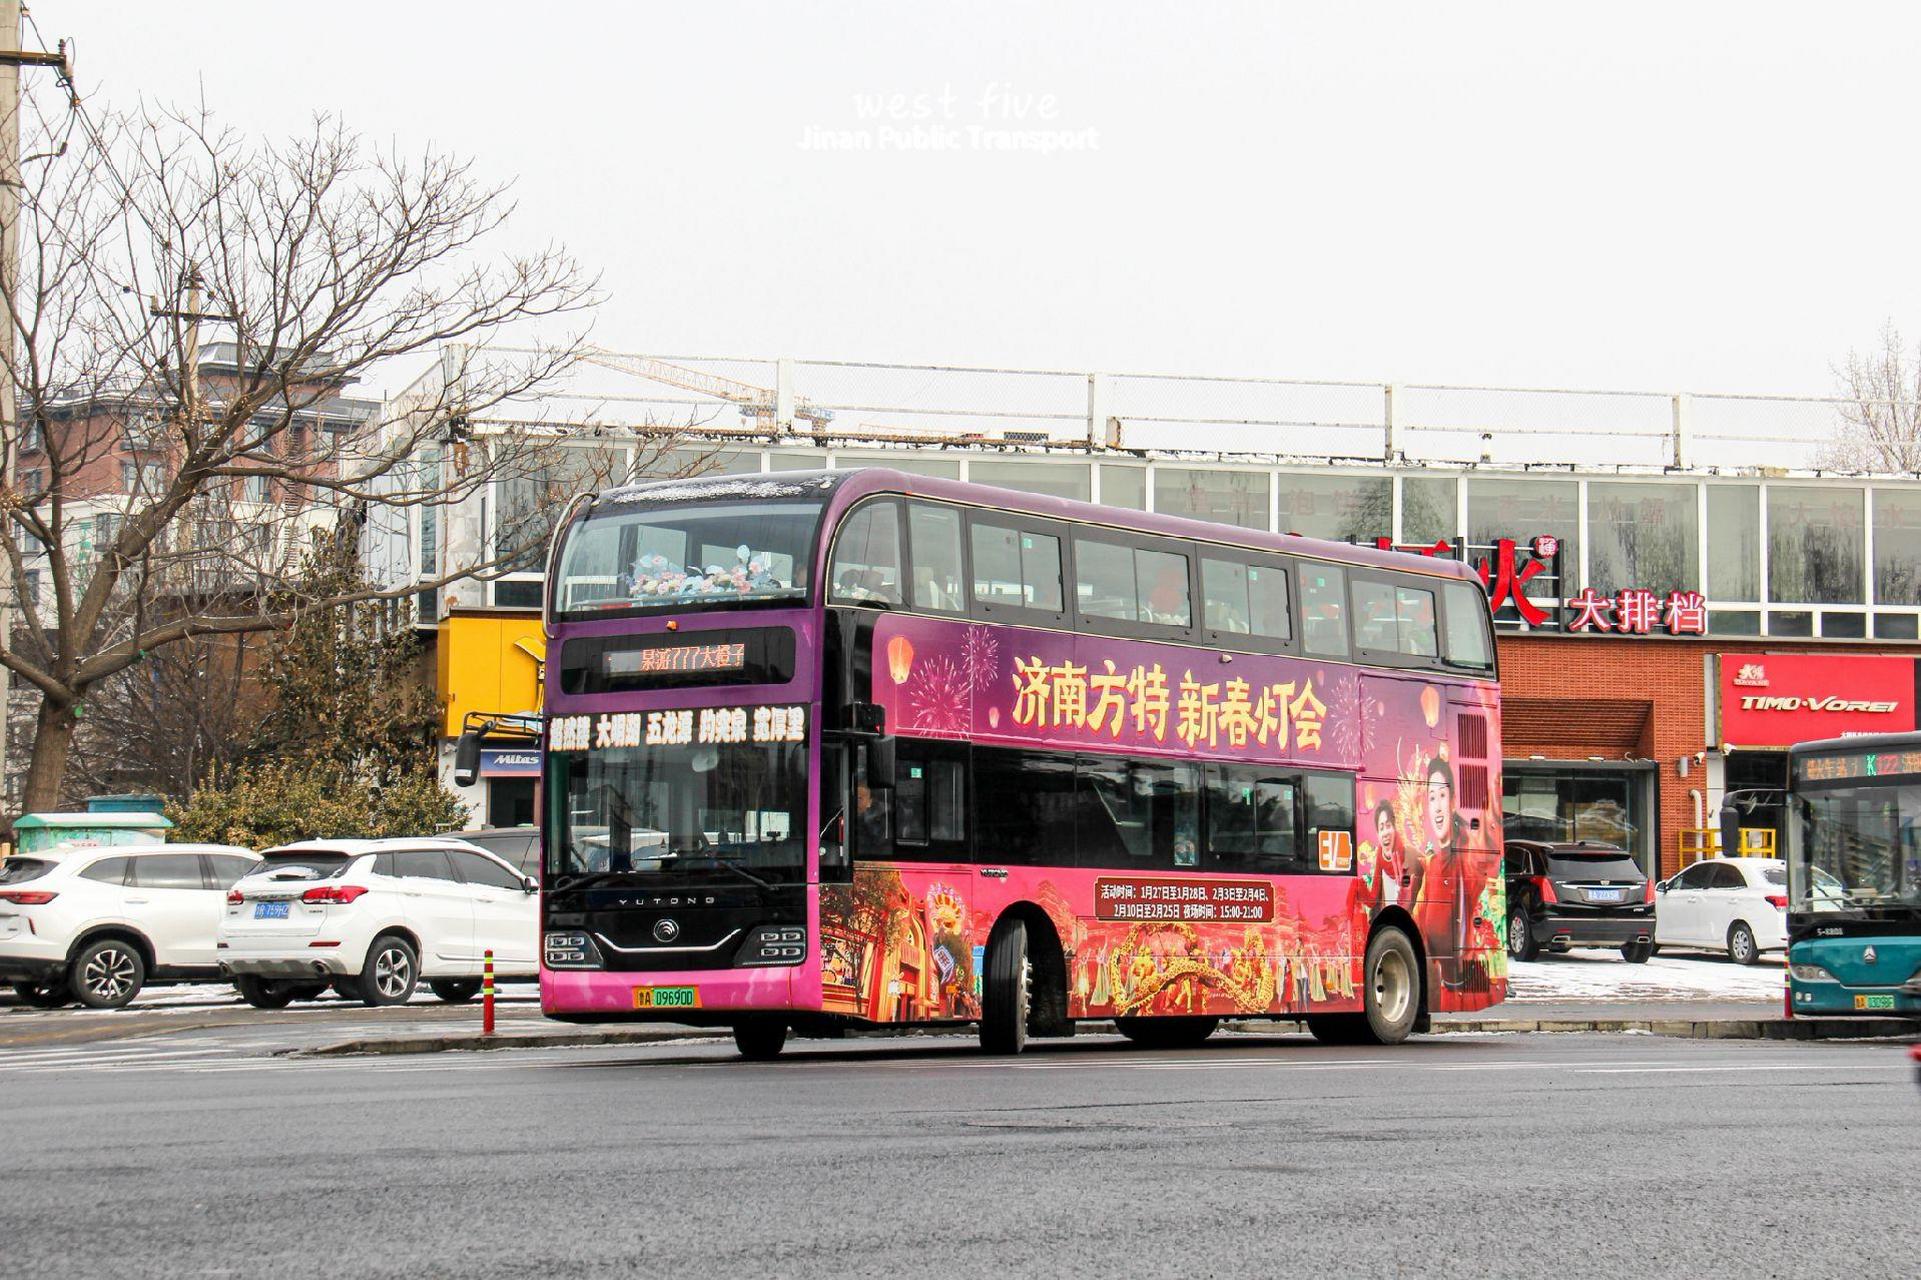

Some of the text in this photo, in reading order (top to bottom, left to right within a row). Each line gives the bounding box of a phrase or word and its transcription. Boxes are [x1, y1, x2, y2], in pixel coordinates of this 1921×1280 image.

[1568, 587, 1707, 635] 大排档
[1012, 655, 1327, 751] 济南方特 新春灯会
[619, 896, 715, 906] YUTONG
